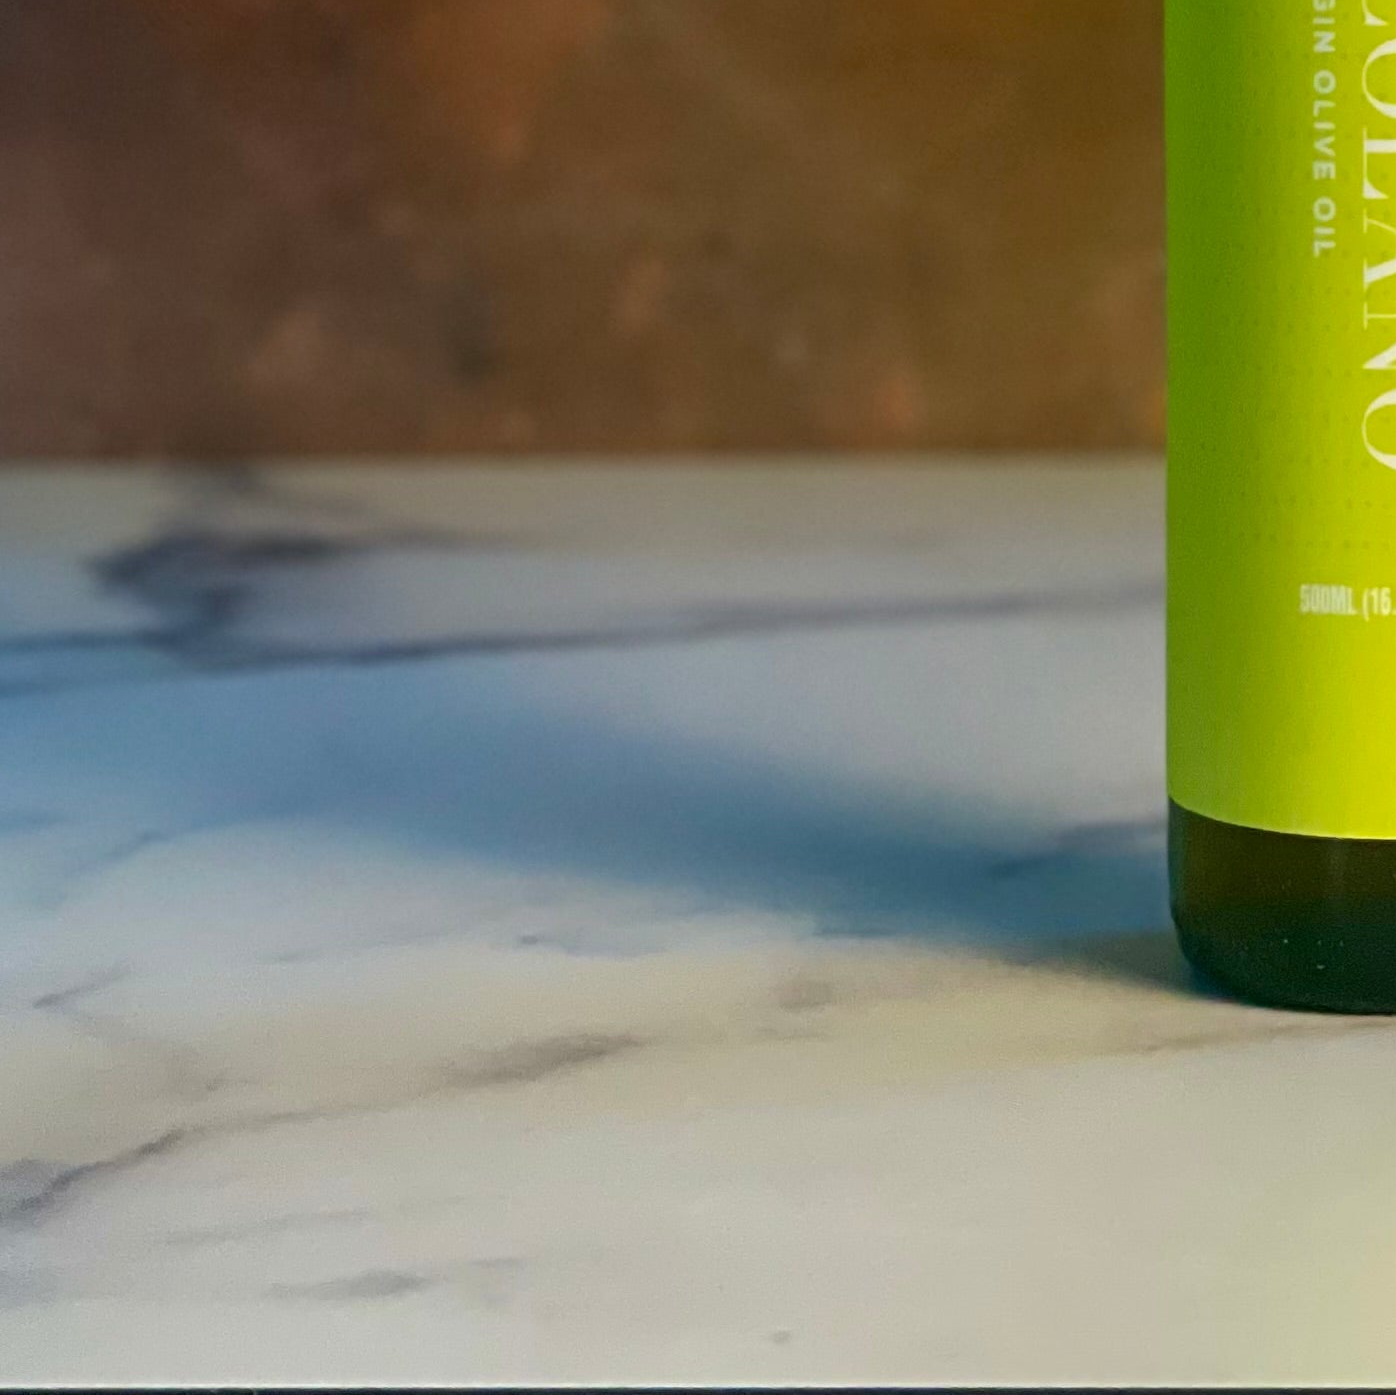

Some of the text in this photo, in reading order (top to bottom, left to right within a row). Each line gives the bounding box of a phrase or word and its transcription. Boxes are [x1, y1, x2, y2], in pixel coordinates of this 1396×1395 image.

[1311, 69, 1337, 180] OLIVE
[1311, 196, 1337, 258] OIL
[1299, 582, 1357, 616] 500ML
